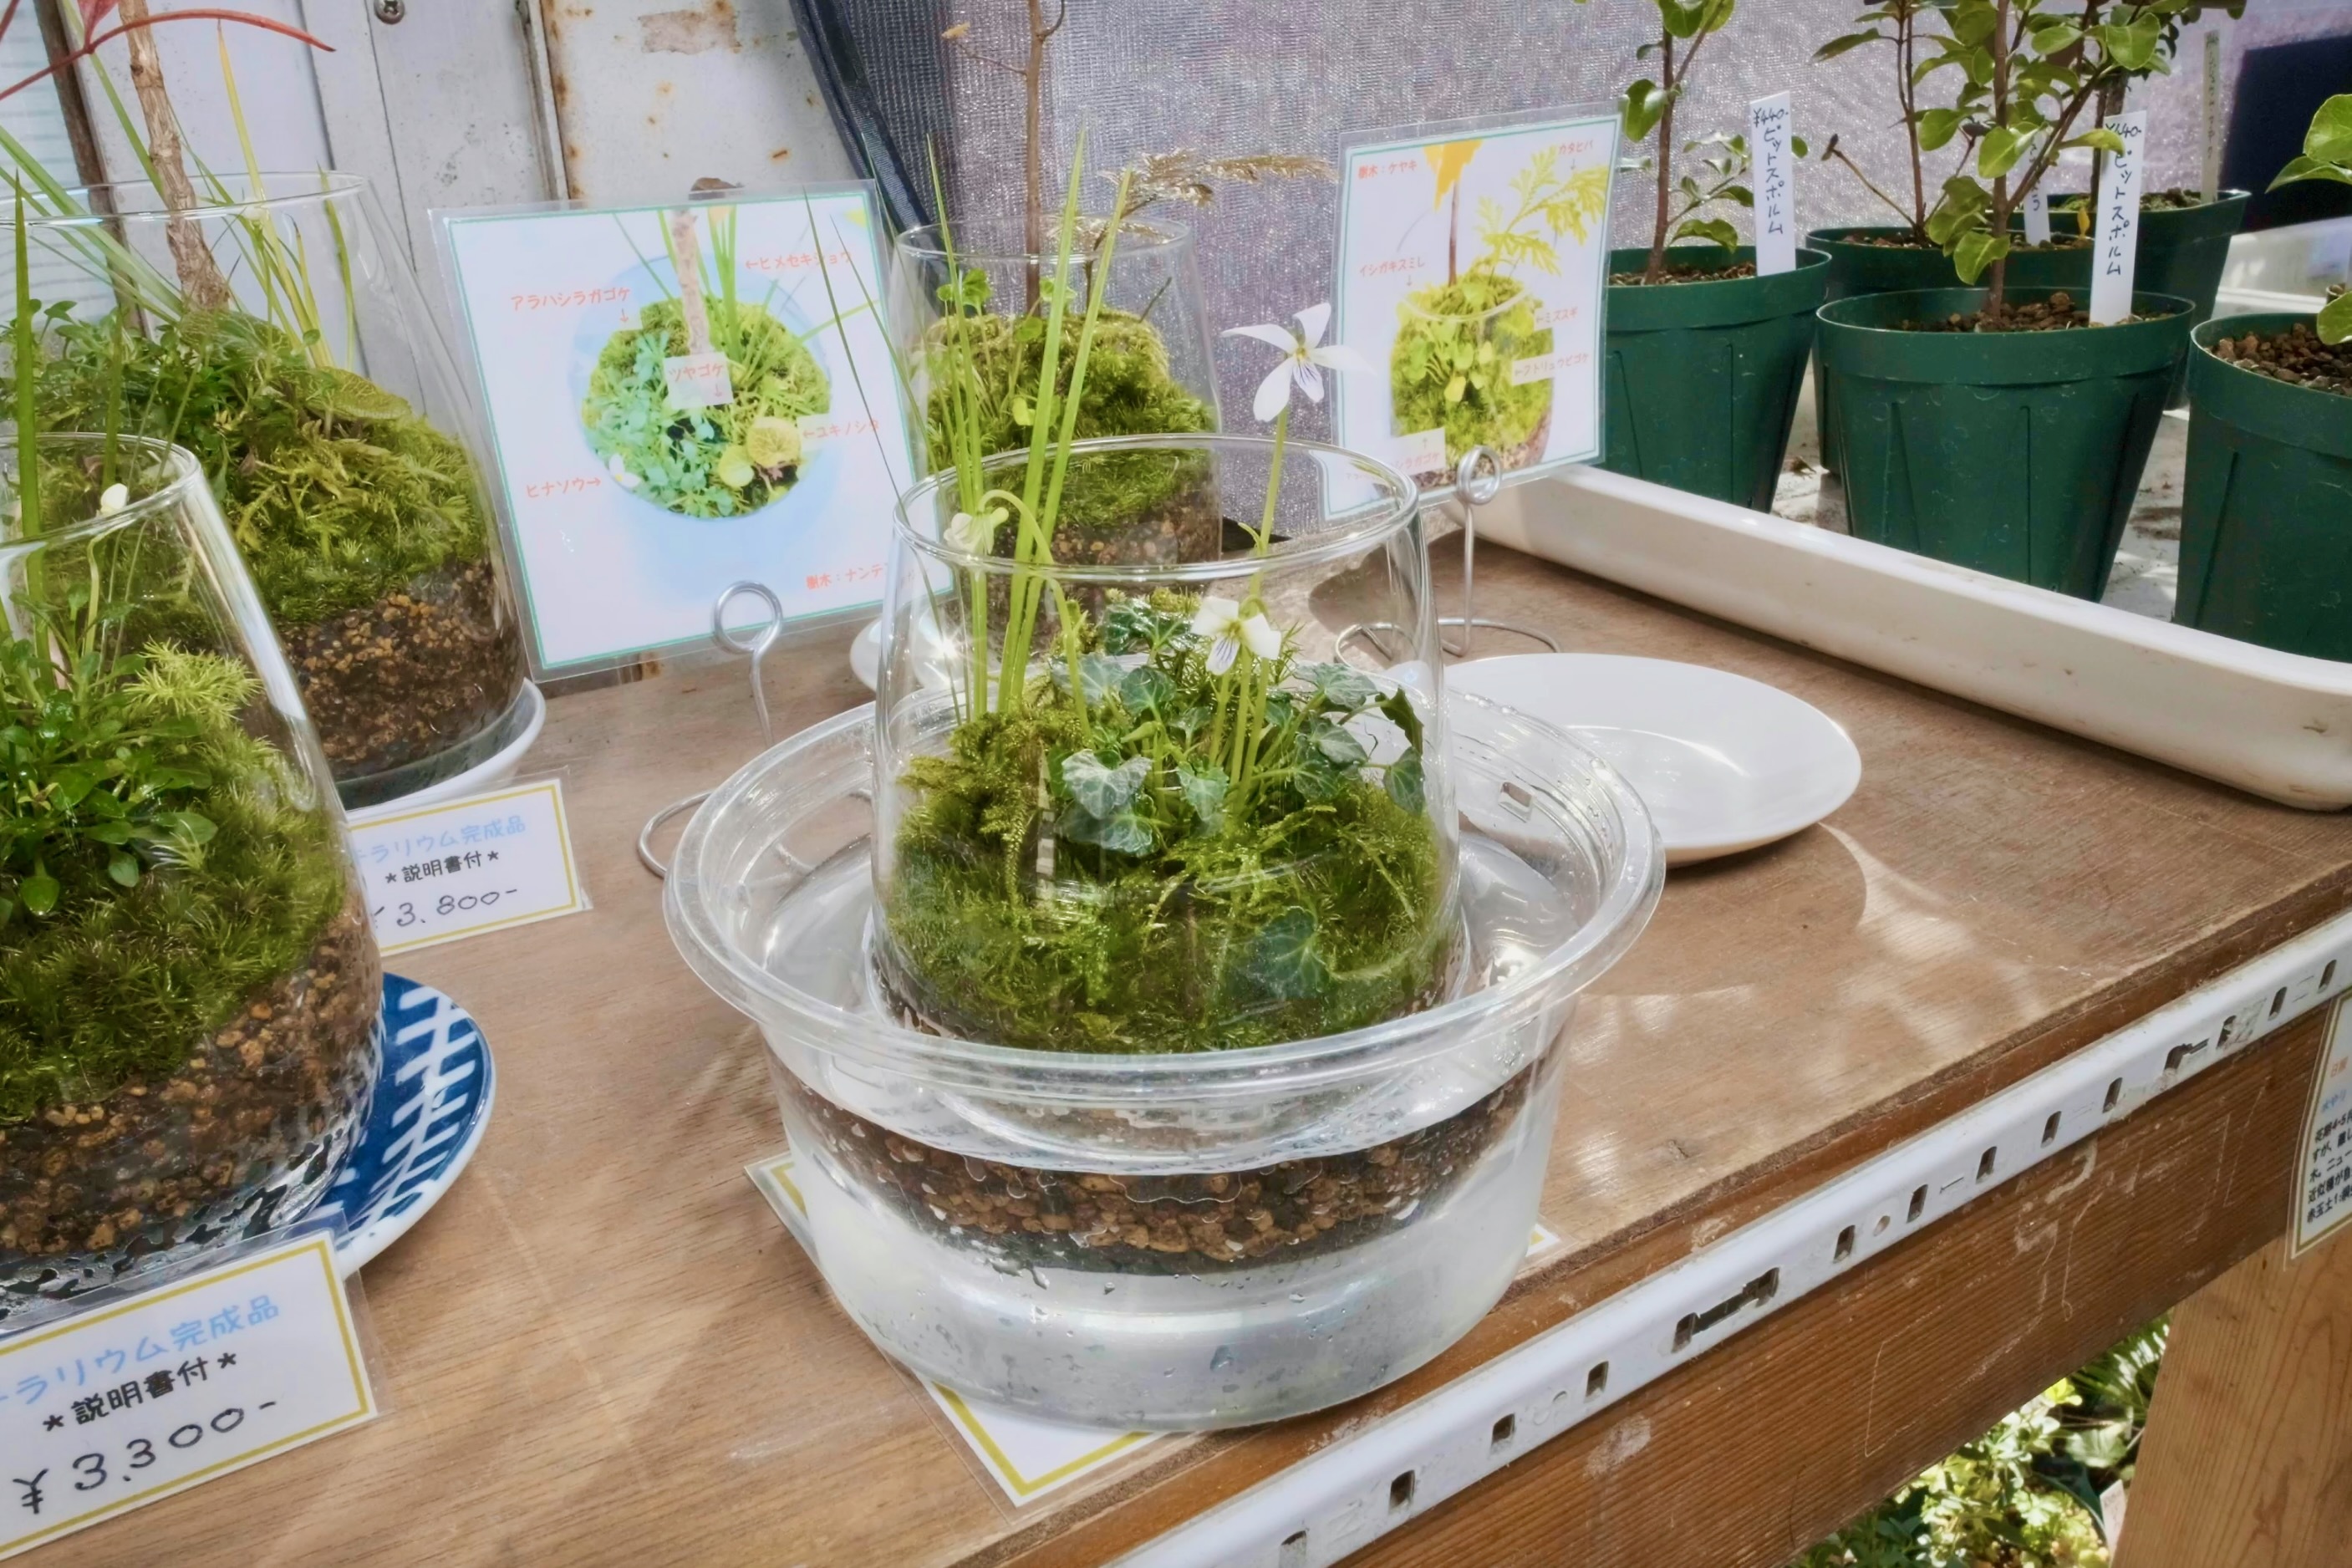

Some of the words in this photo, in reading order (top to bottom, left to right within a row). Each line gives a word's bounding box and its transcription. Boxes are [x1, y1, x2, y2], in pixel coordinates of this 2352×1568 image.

[510, 287, 631, 312] アラハシラガゴケ
[669, 363, 724, 383] ツヤゴケ
[525, 476, 587, 499] ヒナソウ
[806, 562, 888, 590] 樹木：ナンテ
[0, 1294, 280, 1406] ラリウム完成品
